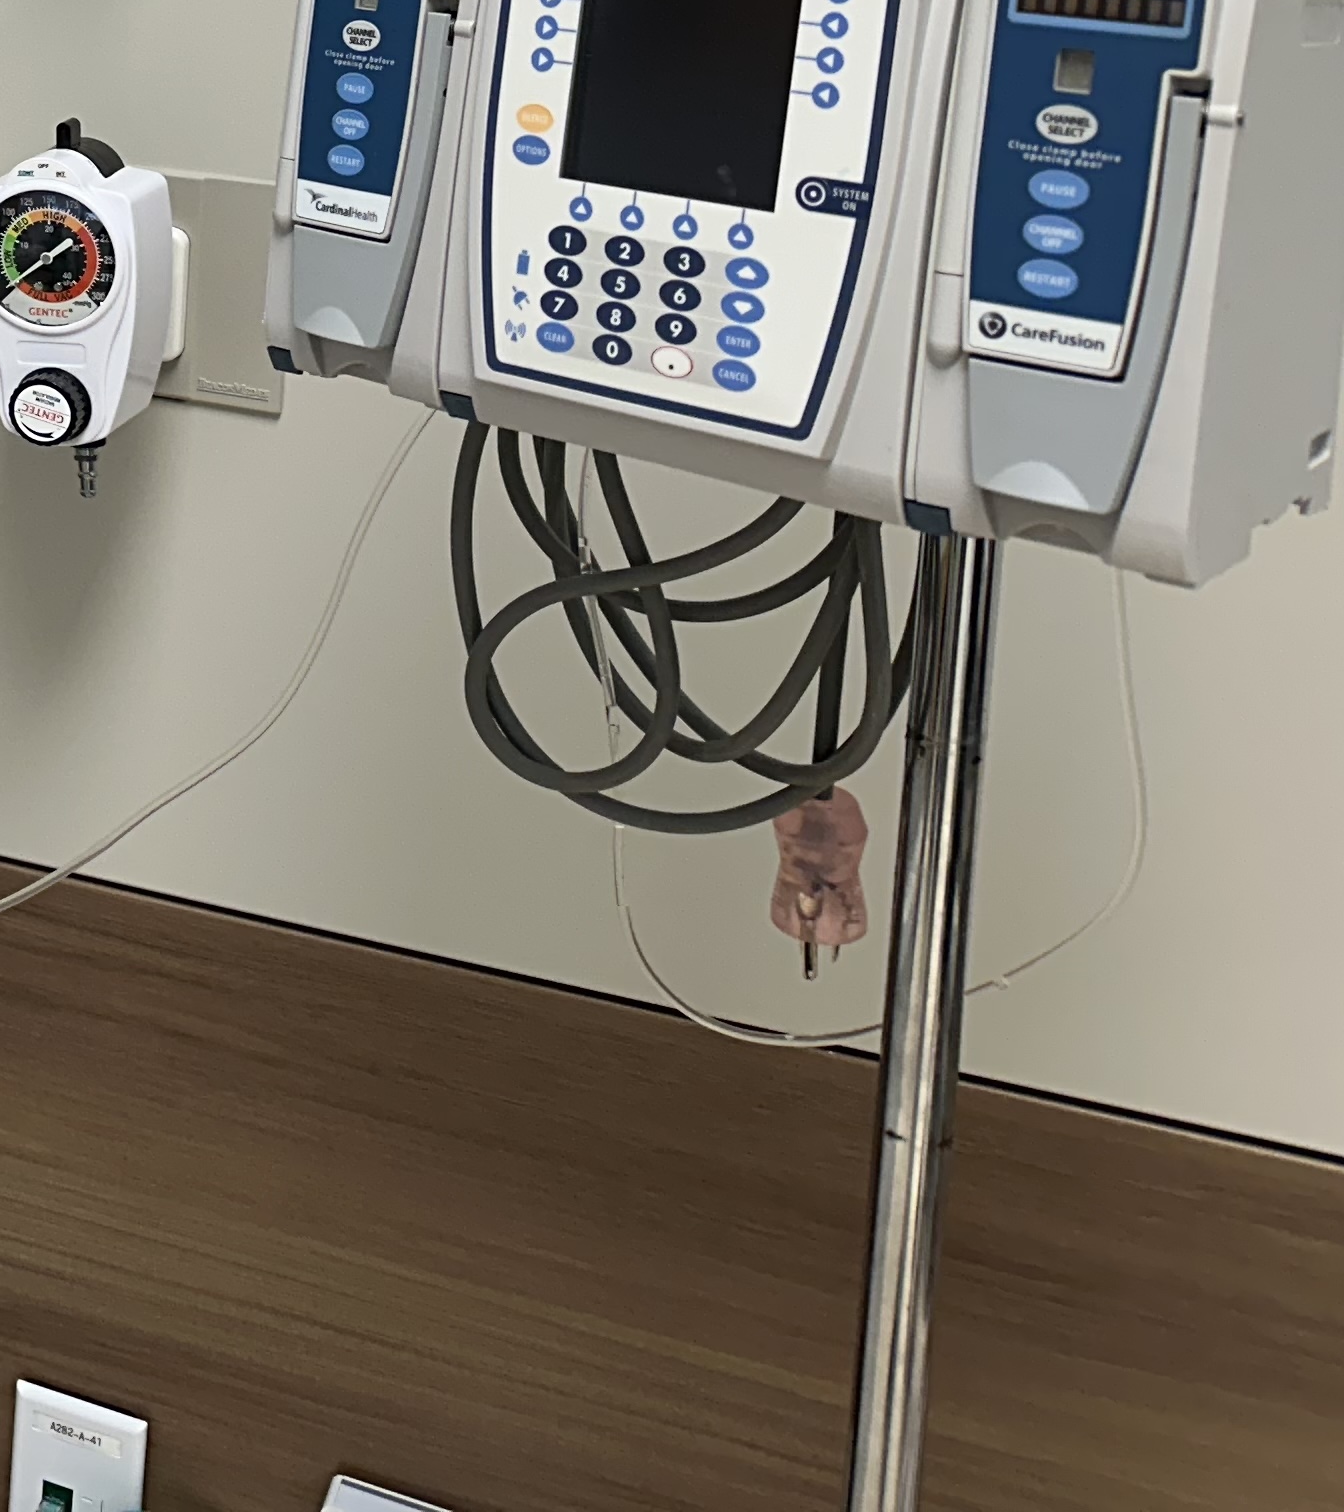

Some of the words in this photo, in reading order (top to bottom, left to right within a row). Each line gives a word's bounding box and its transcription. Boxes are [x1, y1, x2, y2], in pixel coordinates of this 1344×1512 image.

[345, 25, 377, 39] CHANNEL
[348, 36, 373, 48] SELECT
[324, 48, 344, 59] Close
[345, 52, 368, 64] clamp
[369, 54, 396, 67] before
[333, 57, 363, 71] opening
[364, 61, 384, 72] door
[343, 82, 367, 95] PAUSE
[335, 115, 366, 130] CHANNEL
[1042, 111, 1092, 129] CHANNEL
[343, 127, 357, 137] OFF
[1048, 123, 1086, 139] SELECT
[515, 143, 548, 158] OPTIONS
[1007, 139, 1040, 152] Close
[1042, 143, 1078, 159] clamp
[1080, 148, 1122, 164] before
[330, 153, 362, 168] RESTART
[1022, 151, 1072, 168] opening
[1074, 156, 1104, 170] door
[832, 187, 870, 202] SYSTEM
[1040, 182, 1078, 198] PAUSE
[20, 197, 34, 207] 125
[42, 195, 56, 204] 150
[842, 200, 857, 212] ON
[2, 207, 16, 217] 100
[41, 210, 68, 222] HIGH
[315, 200, 379, 224] CardinalHealth
[12, 216, 30, 234] MED
[44, 226, 54, 234] 20
[1028, 223, 1078, 242] CHANNEL
[20, 241, 29, 249] 10
[564, 233, 572, 248] 1
[1041, 236, 1063, 249] OFF
[619, 243, 630, 259] 2
[4, 249, 13, 269] LOW
[678, 253, 690, 270] 3
[62, 271, 72, 280] 40
[557, 266, 569, 281] 4
[1023, 270, 1071, 287] RESTART
[615, 276, 626, 292] 5
[27, 289, 49, 300] FULL
[53, 289, 72, 302] VAC
[674, 288, 686, 304] 6
[28, 307, 69, 319] GENTEC
[553, 299, 565, 313] 7
[610, 309, 621, 325] 8
[669, 321, 683, 337] 9
[543, 331, 568, 345] CLEAR
[725, 336, 752, 350] ENTER
[1011, 322, 1106, 353] CareFusion
[606, 342, 619, 358] 0
[717, 368, 750, 384] CANCEL
[22, 403, 64, 424] GENTEC
[49, 1420, 103, 1448] A282-A-41
